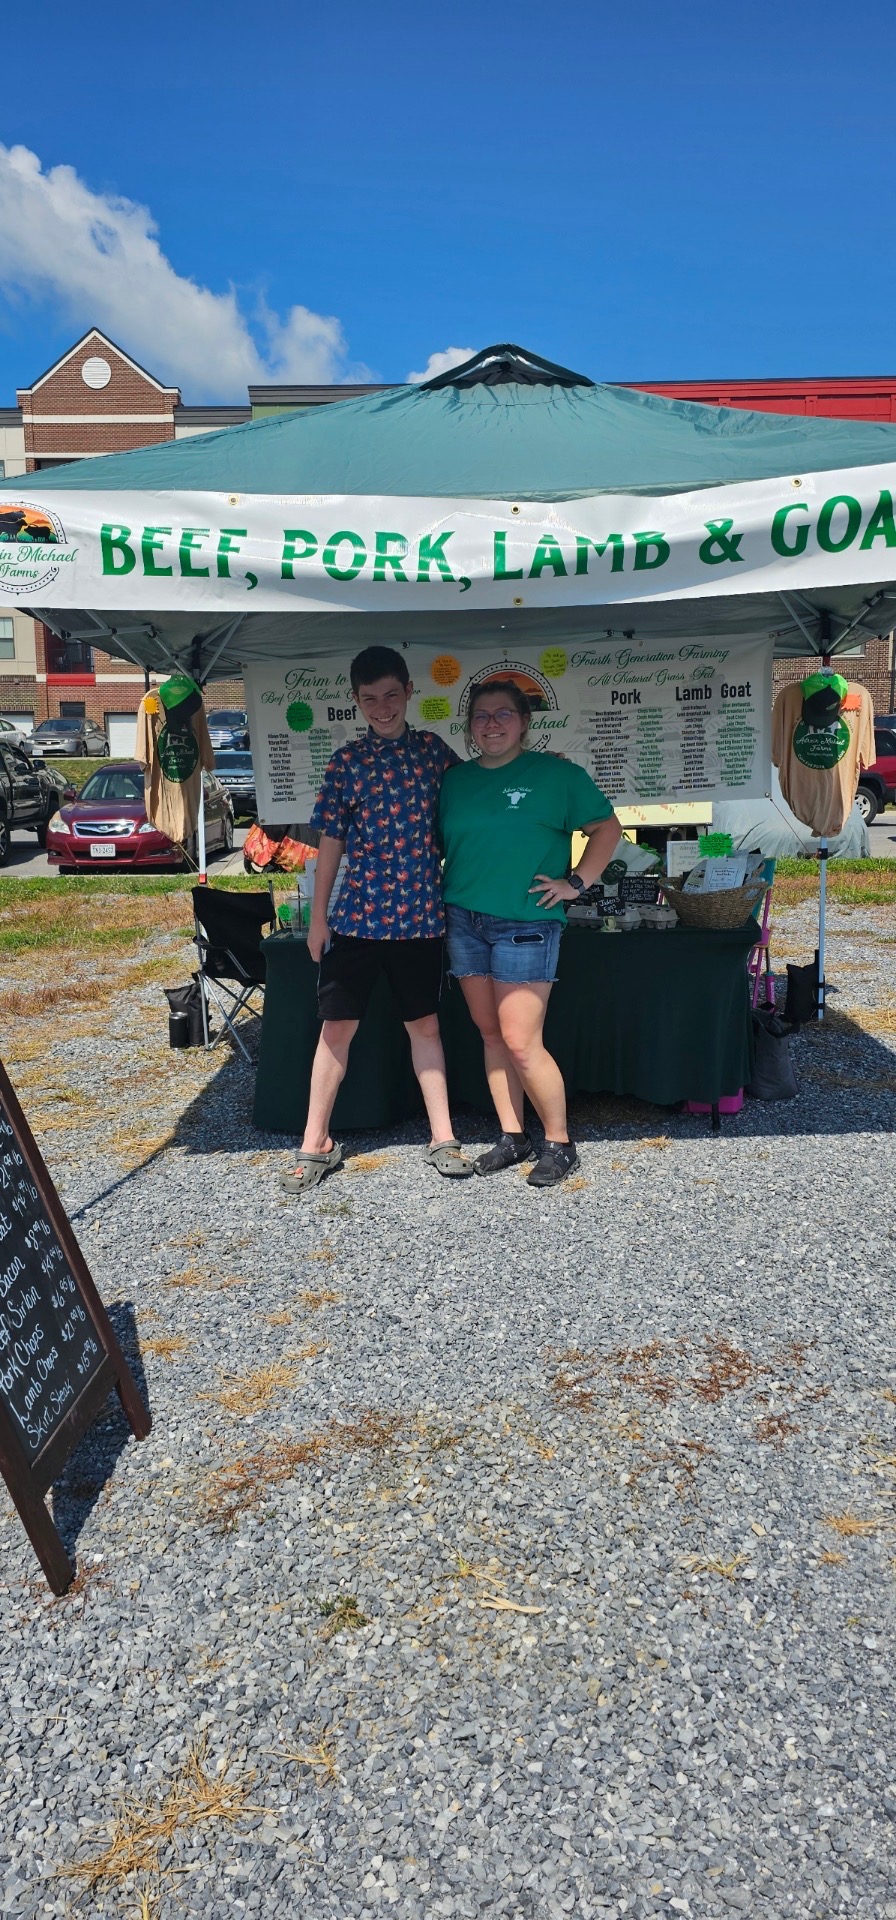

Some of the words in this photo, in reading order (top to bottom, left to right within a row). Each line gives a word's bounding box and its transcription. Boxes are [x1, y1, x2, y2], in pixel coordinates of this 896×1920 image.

[100, 523, 258, 591] BEEF,
[280, 530, 472, 592] PORK,
[493, 530, 671, 581] LAMB
[698, 518, 745, 565] &
[770, 489, 896, 557] GOA
[17, 545, 79, 562] Michael
[0, 562, 39, 579] Farms
[571, 650, 612, 668] Fourth
[615, 649, 676, 670] Generation
[678, 643, 730, 664] Farming
[284, 667, 331, 690] Farm
[588, 672, 610, 687] All
[611, 671, 653, 687] Natural
[654, 668, 685, 687] Grass
[611, 688, 641, 706] Pork
[675, 684, 712, 702] Lamb
[720, 681, 752, 699] Goat
[327, 705, 357, 721] Beef
[528, 714, 570, 731] ichael
[7, 1286, 42, 1329] Sirloin
[14, 1324, 45, 1367] Chops
[10, 1377, 42, 1430] Lamb
[37, 1346, 59, 1381] Chops
[27, 1405, 54, 1448] Skirt
[50, 1378, 75, 1415] Steak
